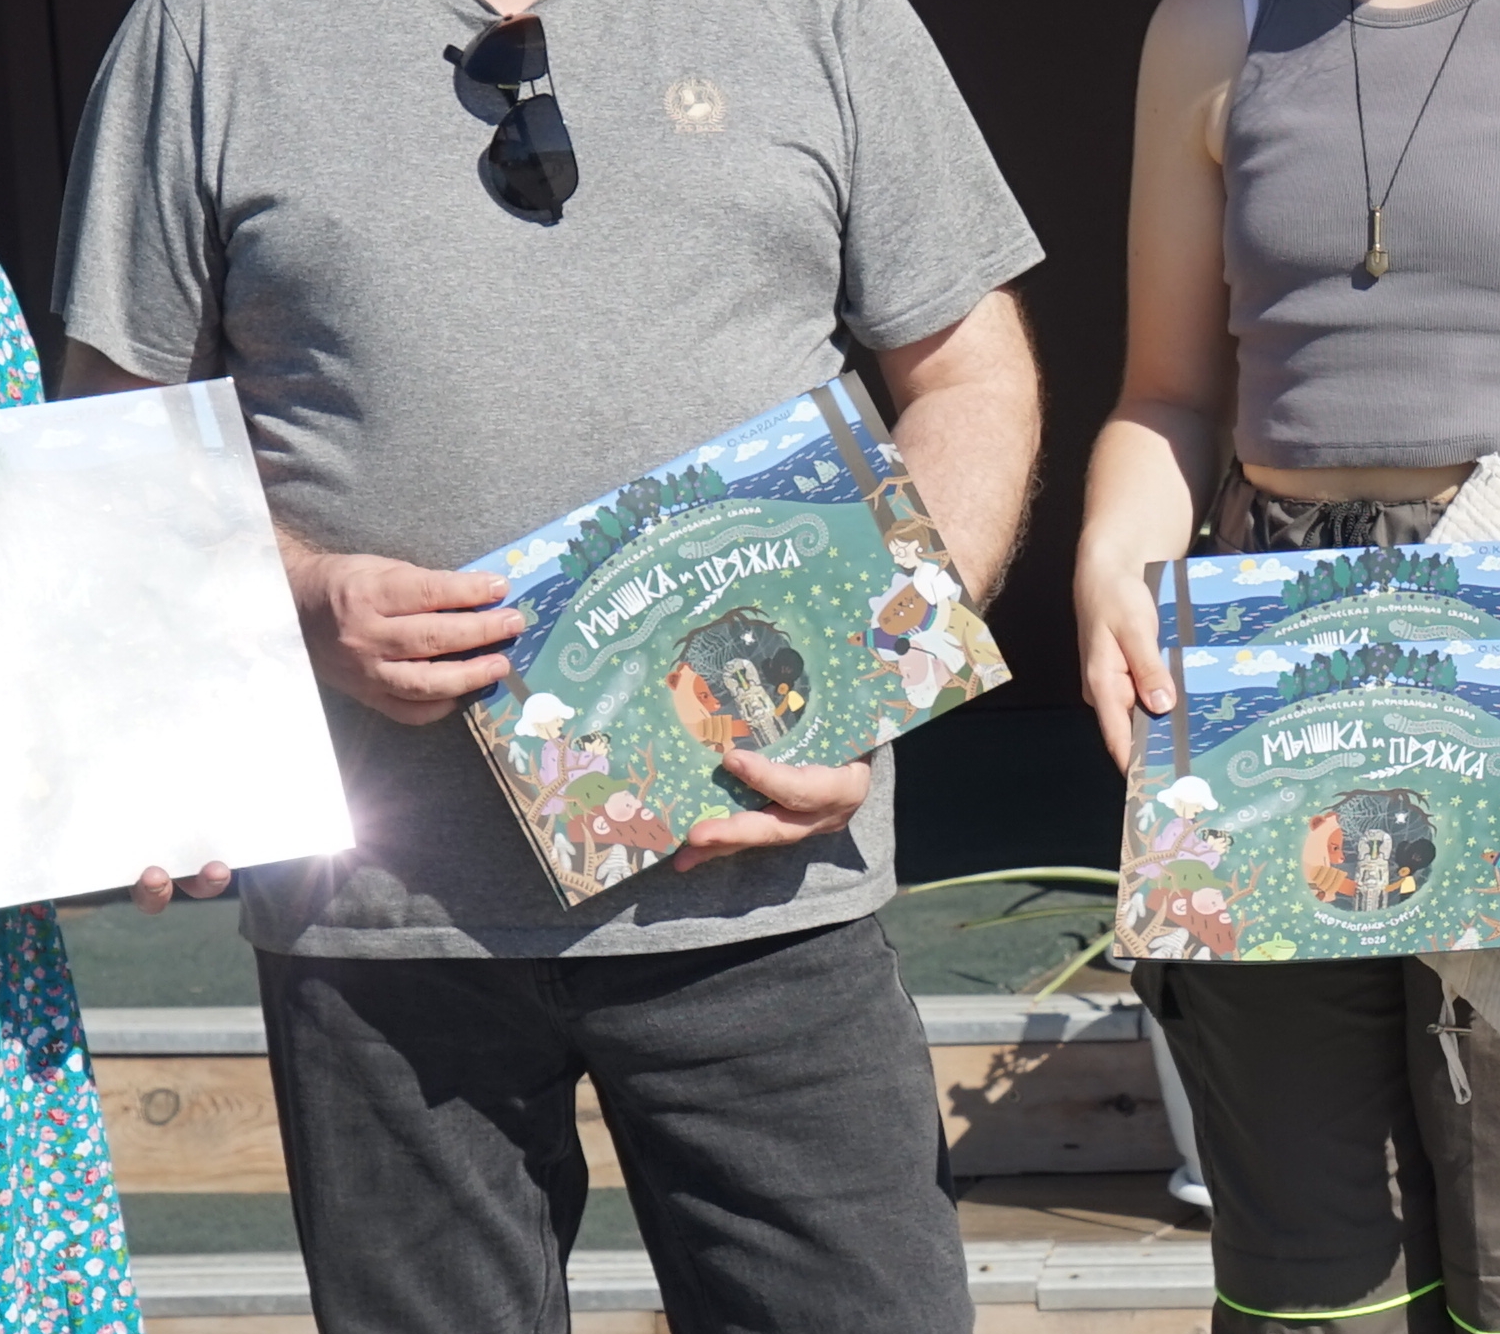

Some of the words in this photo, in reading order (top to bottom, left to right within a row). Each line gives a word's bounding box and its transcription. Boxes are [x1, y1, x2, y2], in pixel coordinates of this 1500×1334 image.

[575, 563, 677, 649] МЫШКА
[695, 538, 801, 591] ПРЯЖКА
[1262, 720, 1368, 766] МЫШКА
[1389, 736, 1487, 779] ПРЯЖКА
